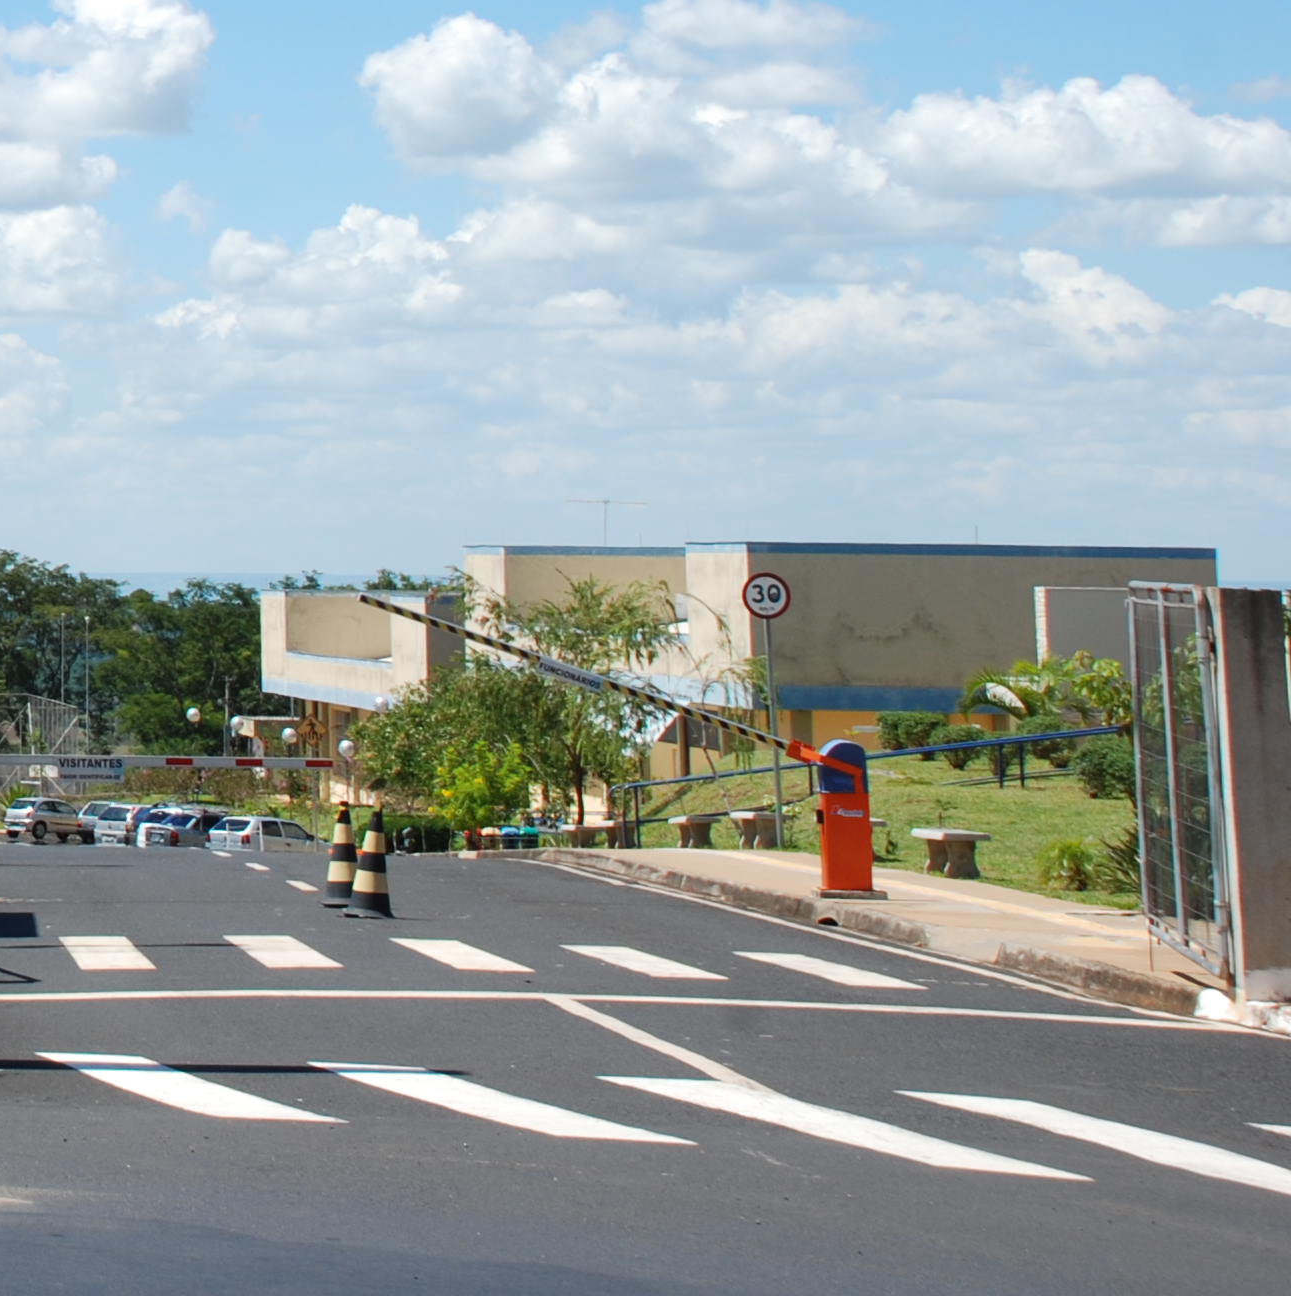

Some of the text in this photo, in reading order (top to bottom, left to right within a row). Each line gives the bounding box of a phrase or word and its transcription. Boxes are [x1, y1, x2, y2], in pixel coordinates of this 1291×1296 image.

[751, 584, 781, 603] 30
[539, 662, 601, 689] FUNCIONÁRIOS
[59, 758, 122, 769] VISITANTES
